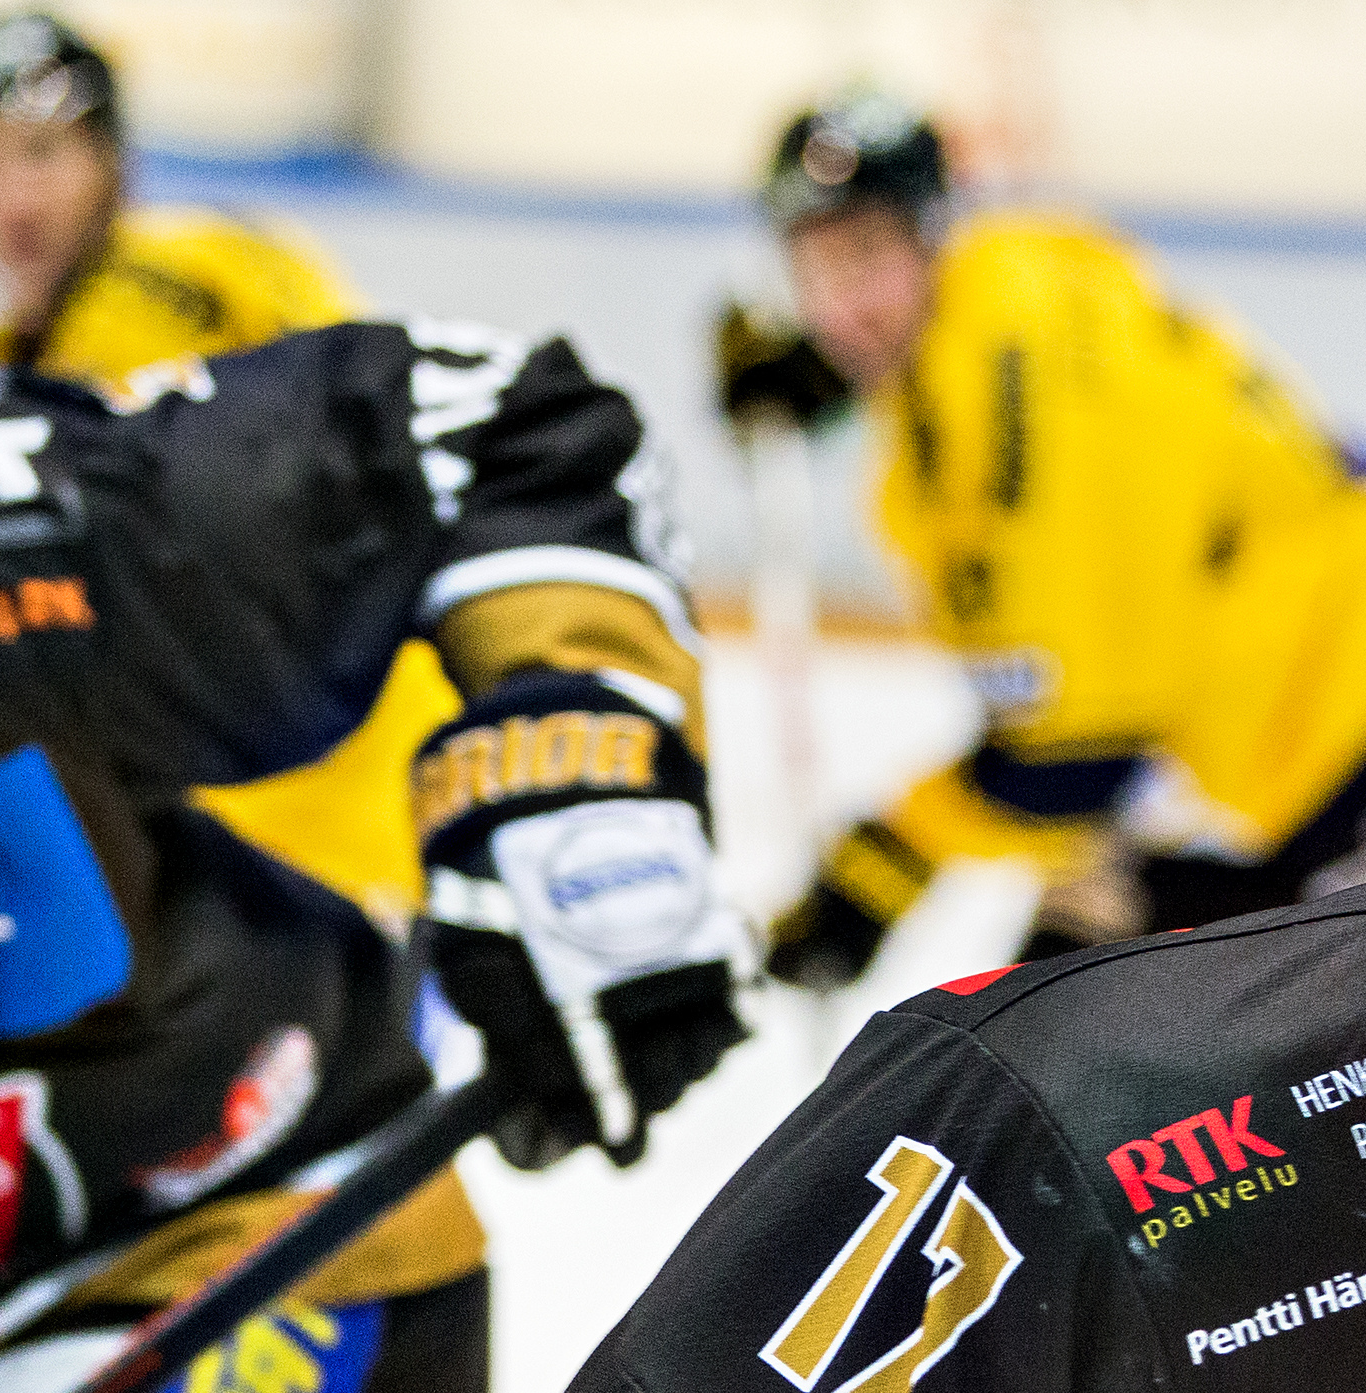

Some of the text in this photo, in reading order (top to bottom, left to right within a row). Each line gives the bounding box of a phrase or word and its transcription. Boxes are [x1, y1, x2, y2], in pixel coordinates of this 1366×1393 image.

[1105, 1094, 1287, 1214] RTK
[1141, 1163, 1300, 1249] palvelu
[1186, 1293, 1305, 1366] Pentti
